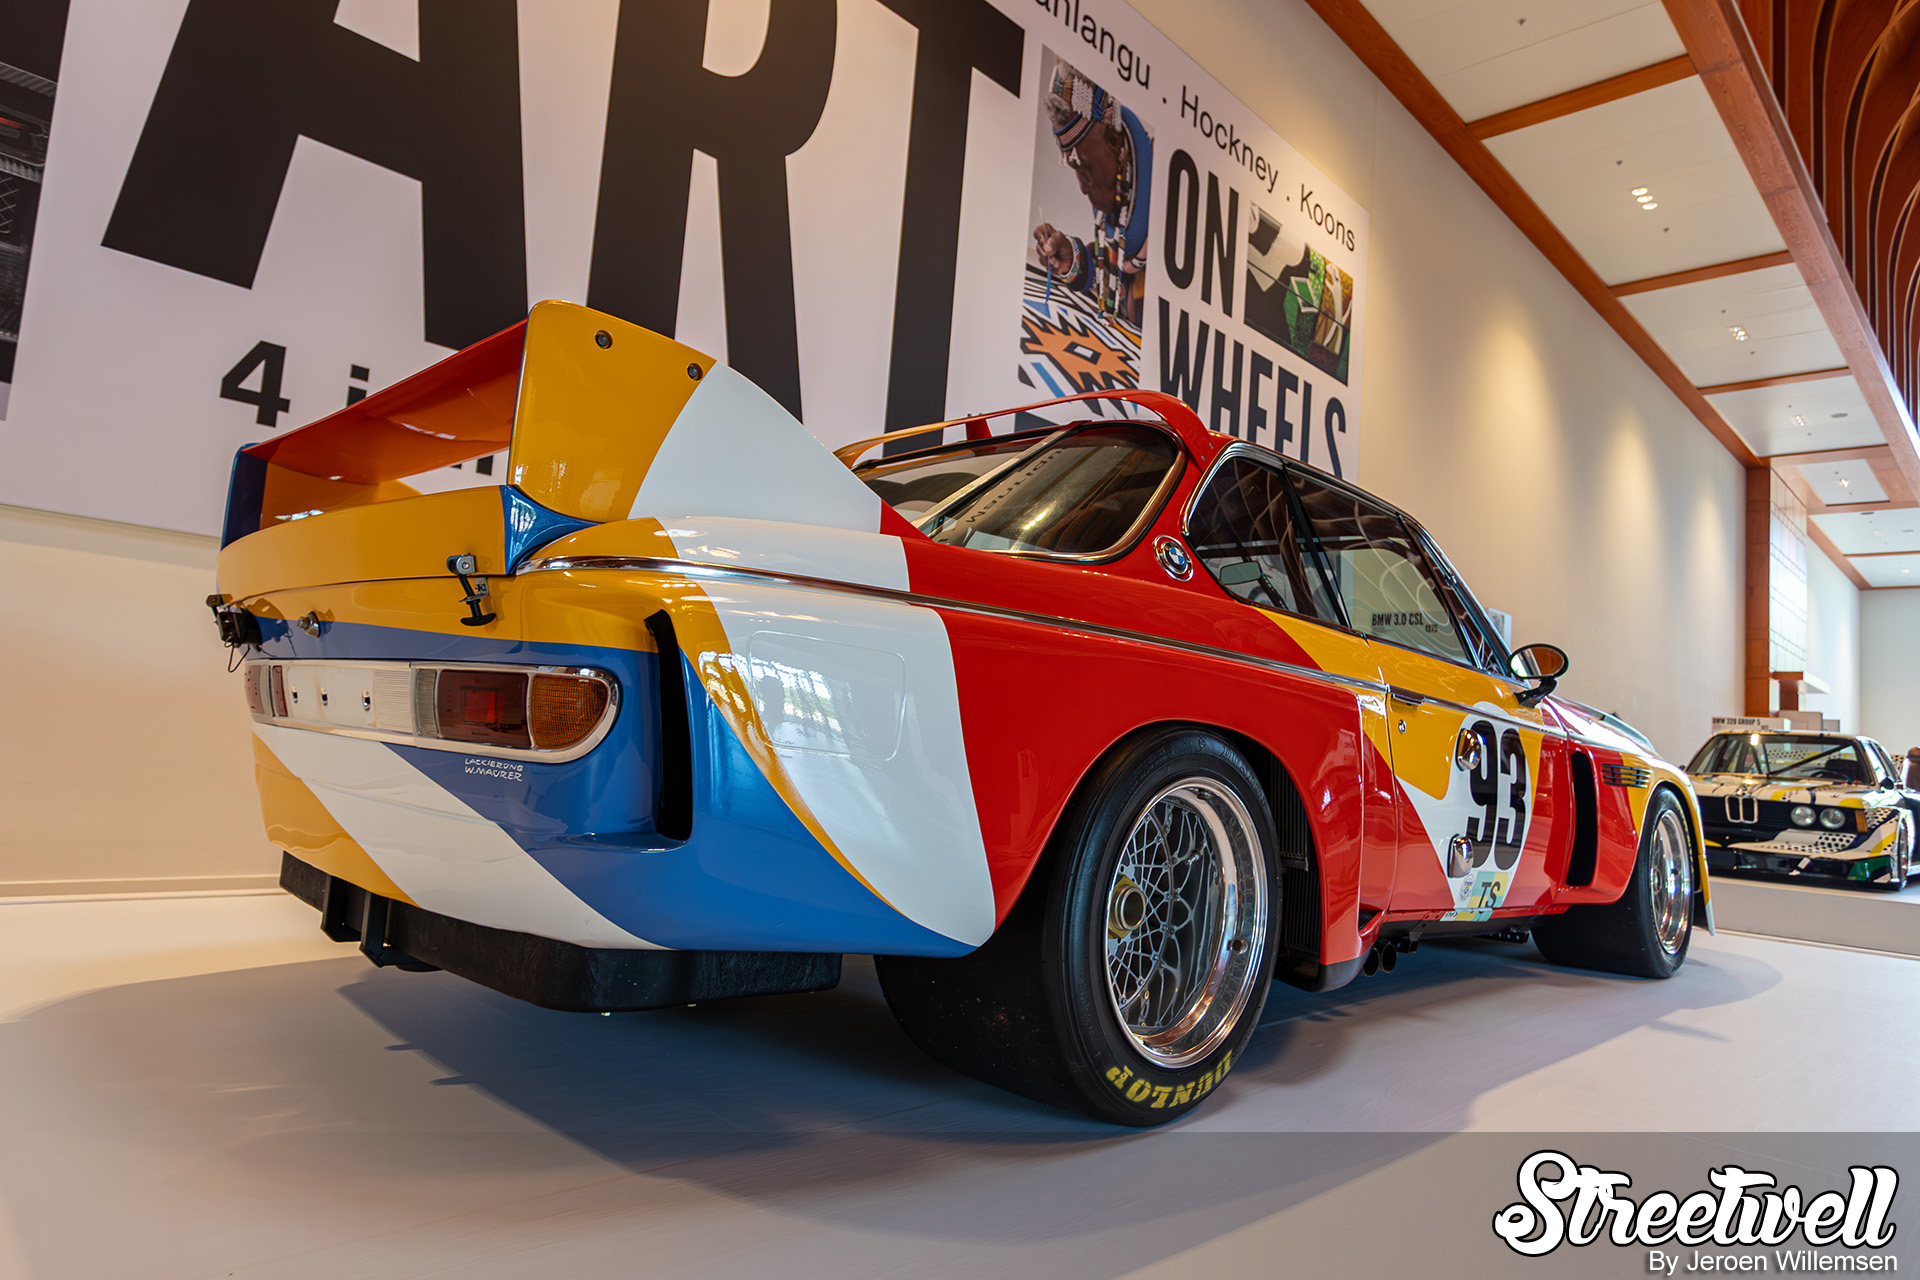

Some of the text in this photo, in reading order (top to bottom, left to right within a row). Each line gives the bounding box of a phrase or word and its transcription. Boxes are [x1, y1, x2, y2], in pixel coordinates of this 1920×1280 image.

[1180, 84, 1279, 194] Hockney
[1300, 183, 1356, 252] Koons
[1163, 147, 1240, 318] ON
[219, 340, 291, 428] 4
[1371, 612, 1424, 626] BMW 3.0 CSL
[464, 758, 524, 772] LACKIERUNG
[1465, 719, 1527, 871] 93
[1478, 881, 1501, 909] TS
[1105, 1049, 1233, 1109] DUNLOP
